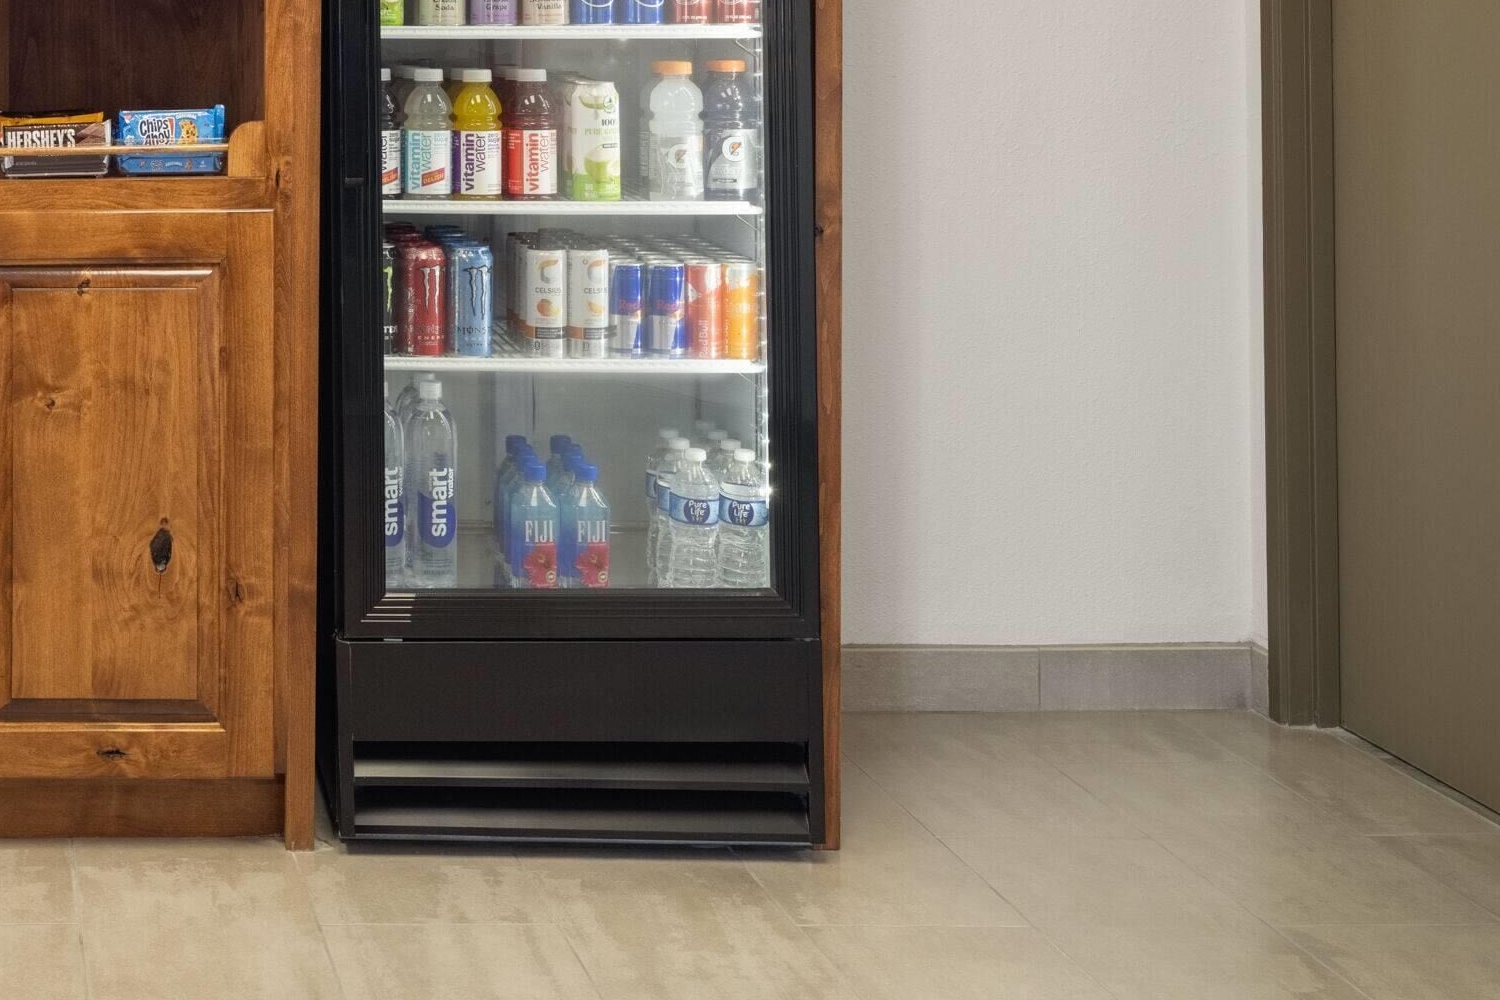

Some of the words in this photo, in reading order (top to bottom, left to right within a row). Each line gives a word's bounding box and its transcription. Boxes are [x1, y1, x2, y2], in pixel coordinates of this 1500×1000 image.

[7, 129, 76, 148] HERSHEY'S
[140, 118, 169, 136] Chips
[410, 132, 421, 190] vitamin
[421, 133, 433, 172] water
[462, 132, 475, 192] vitamin
[476, 133, 486, 173] water
[526, 132, 539, 192] vitamin
[540, 133, 549, 173] water
[423, 171, 445, 185] DELISH
[447, 467, 455, 498] water
[384, 466, 399, 536] smart
[428, 467, 447, 538] smart
[688, 500, 707, 510] Pure
[690, 506, 705, 517] Life
[732, 500, 750, 511] Pure
[733, 507, 749, 519] Life
[525, 520, 554, 543] FIJI
[577, 520, 606, 543] FIJI
